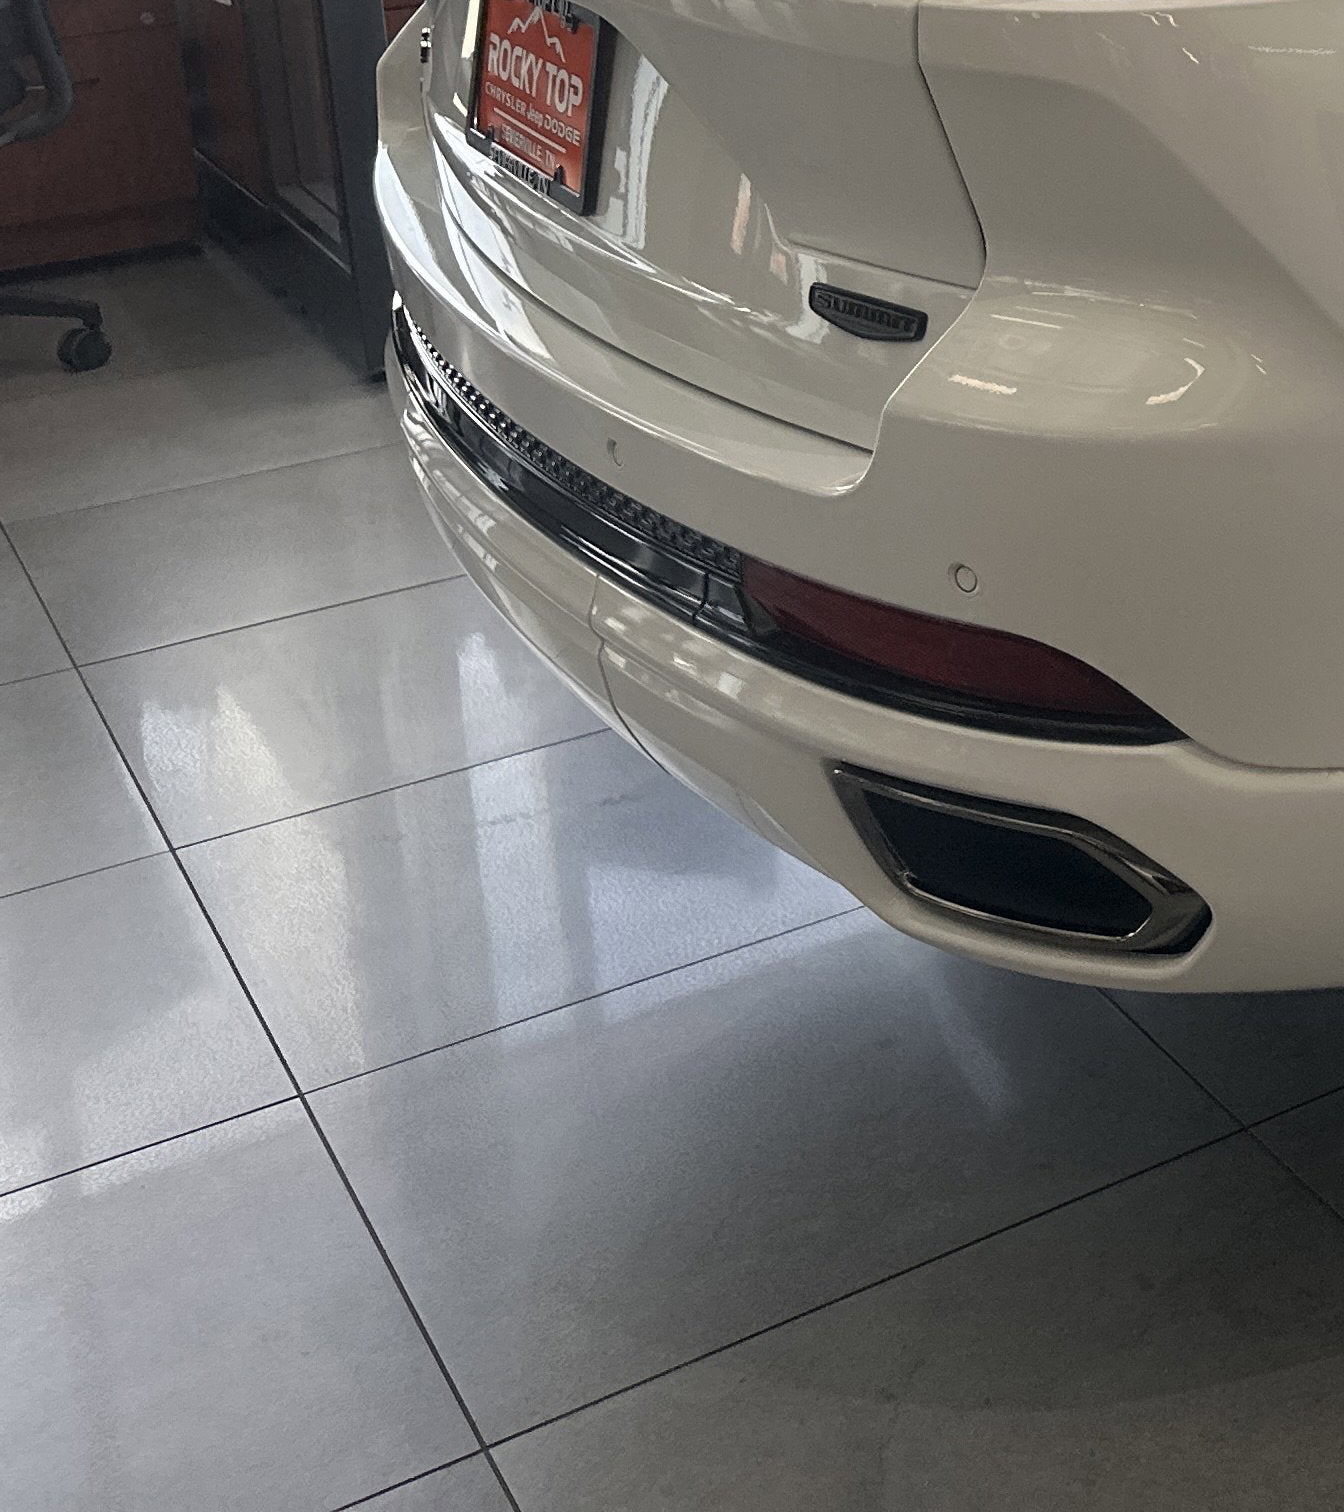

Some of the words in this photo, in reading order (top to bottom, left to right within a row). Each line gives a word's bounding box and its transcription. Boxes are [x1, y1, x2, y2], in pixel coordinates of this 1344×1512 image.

[487, 31, 544, 97] ROCKY
[545, 60, 584, 118] TOP
[485, 81, 526, 117] CHRYSLER
[543, 113, 582, 147] DODGE
